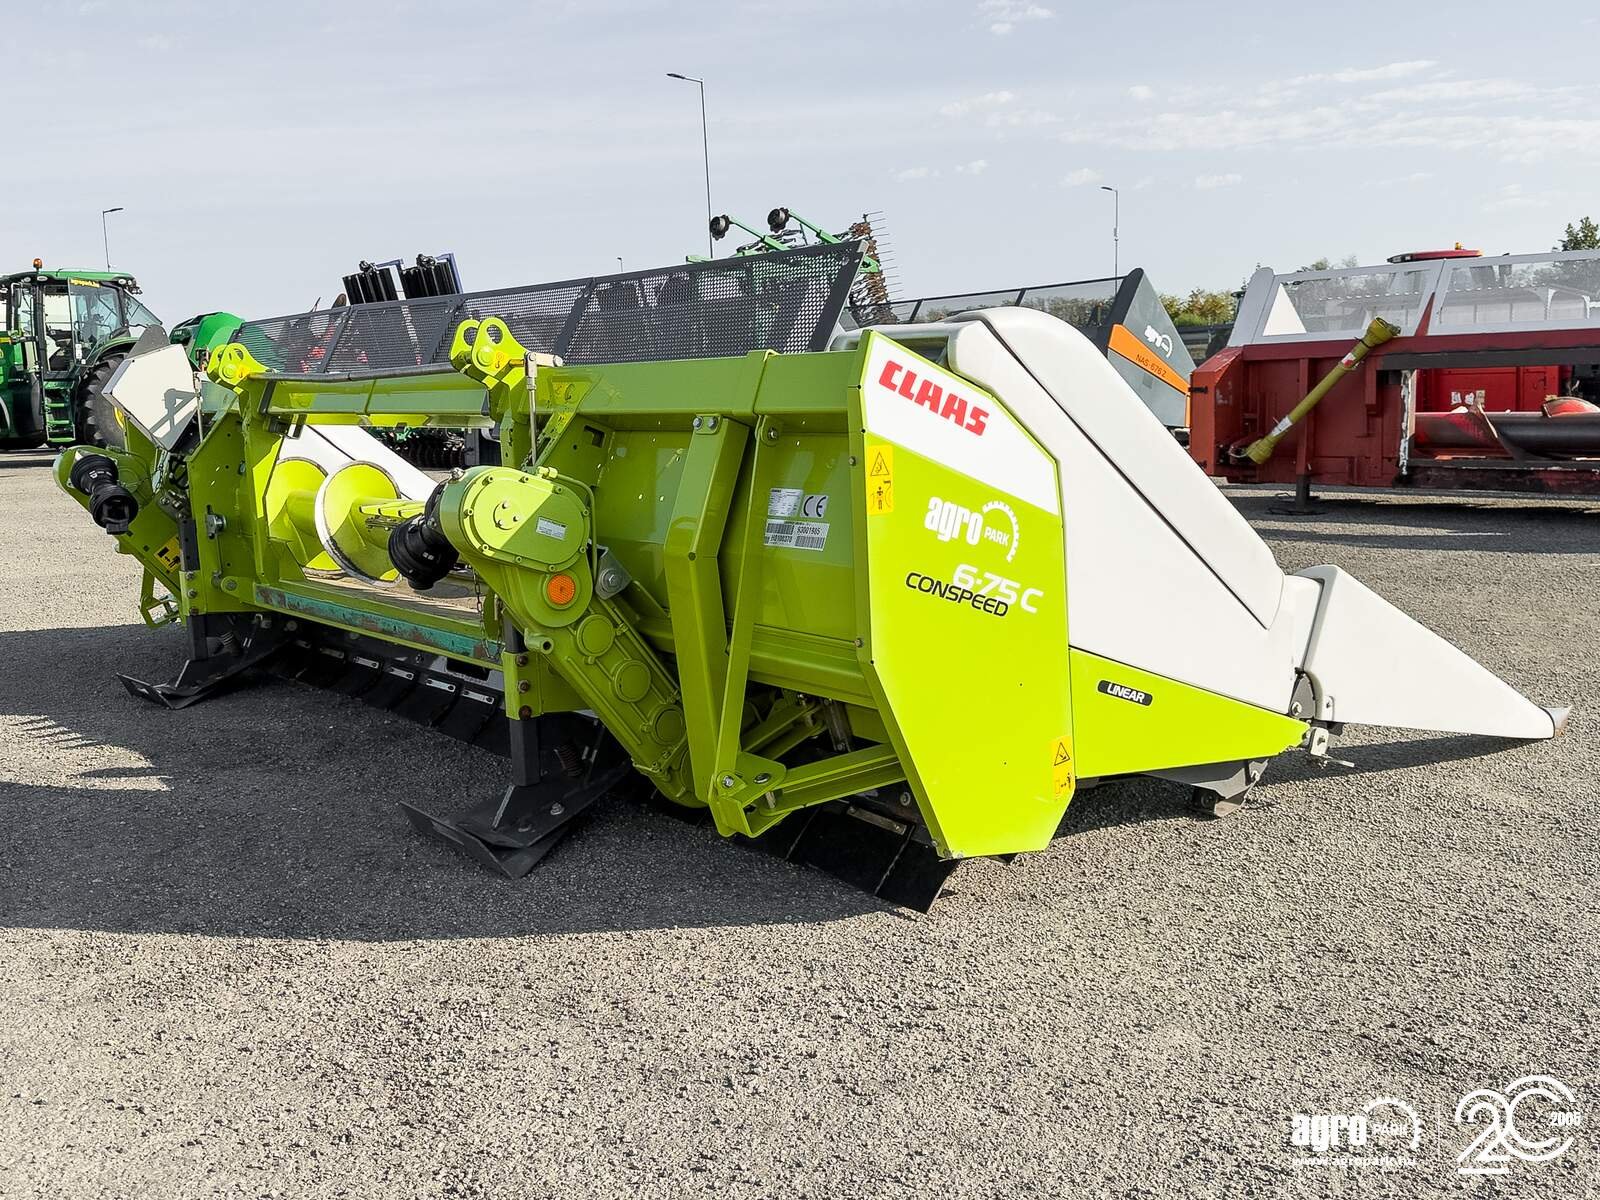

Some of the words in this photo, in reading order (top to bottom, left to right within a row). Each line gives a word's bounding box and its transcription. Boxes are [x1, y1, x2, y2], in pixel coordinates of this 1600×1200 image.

[878, 360, 990, 436] CLAAS
[924, 496, 984, 546] agro
[983, 526, 1010, 547] PARK
[904, 572, 1009, 617] CONSPEED
[1106, 683, 1146, 703] LINEAR
